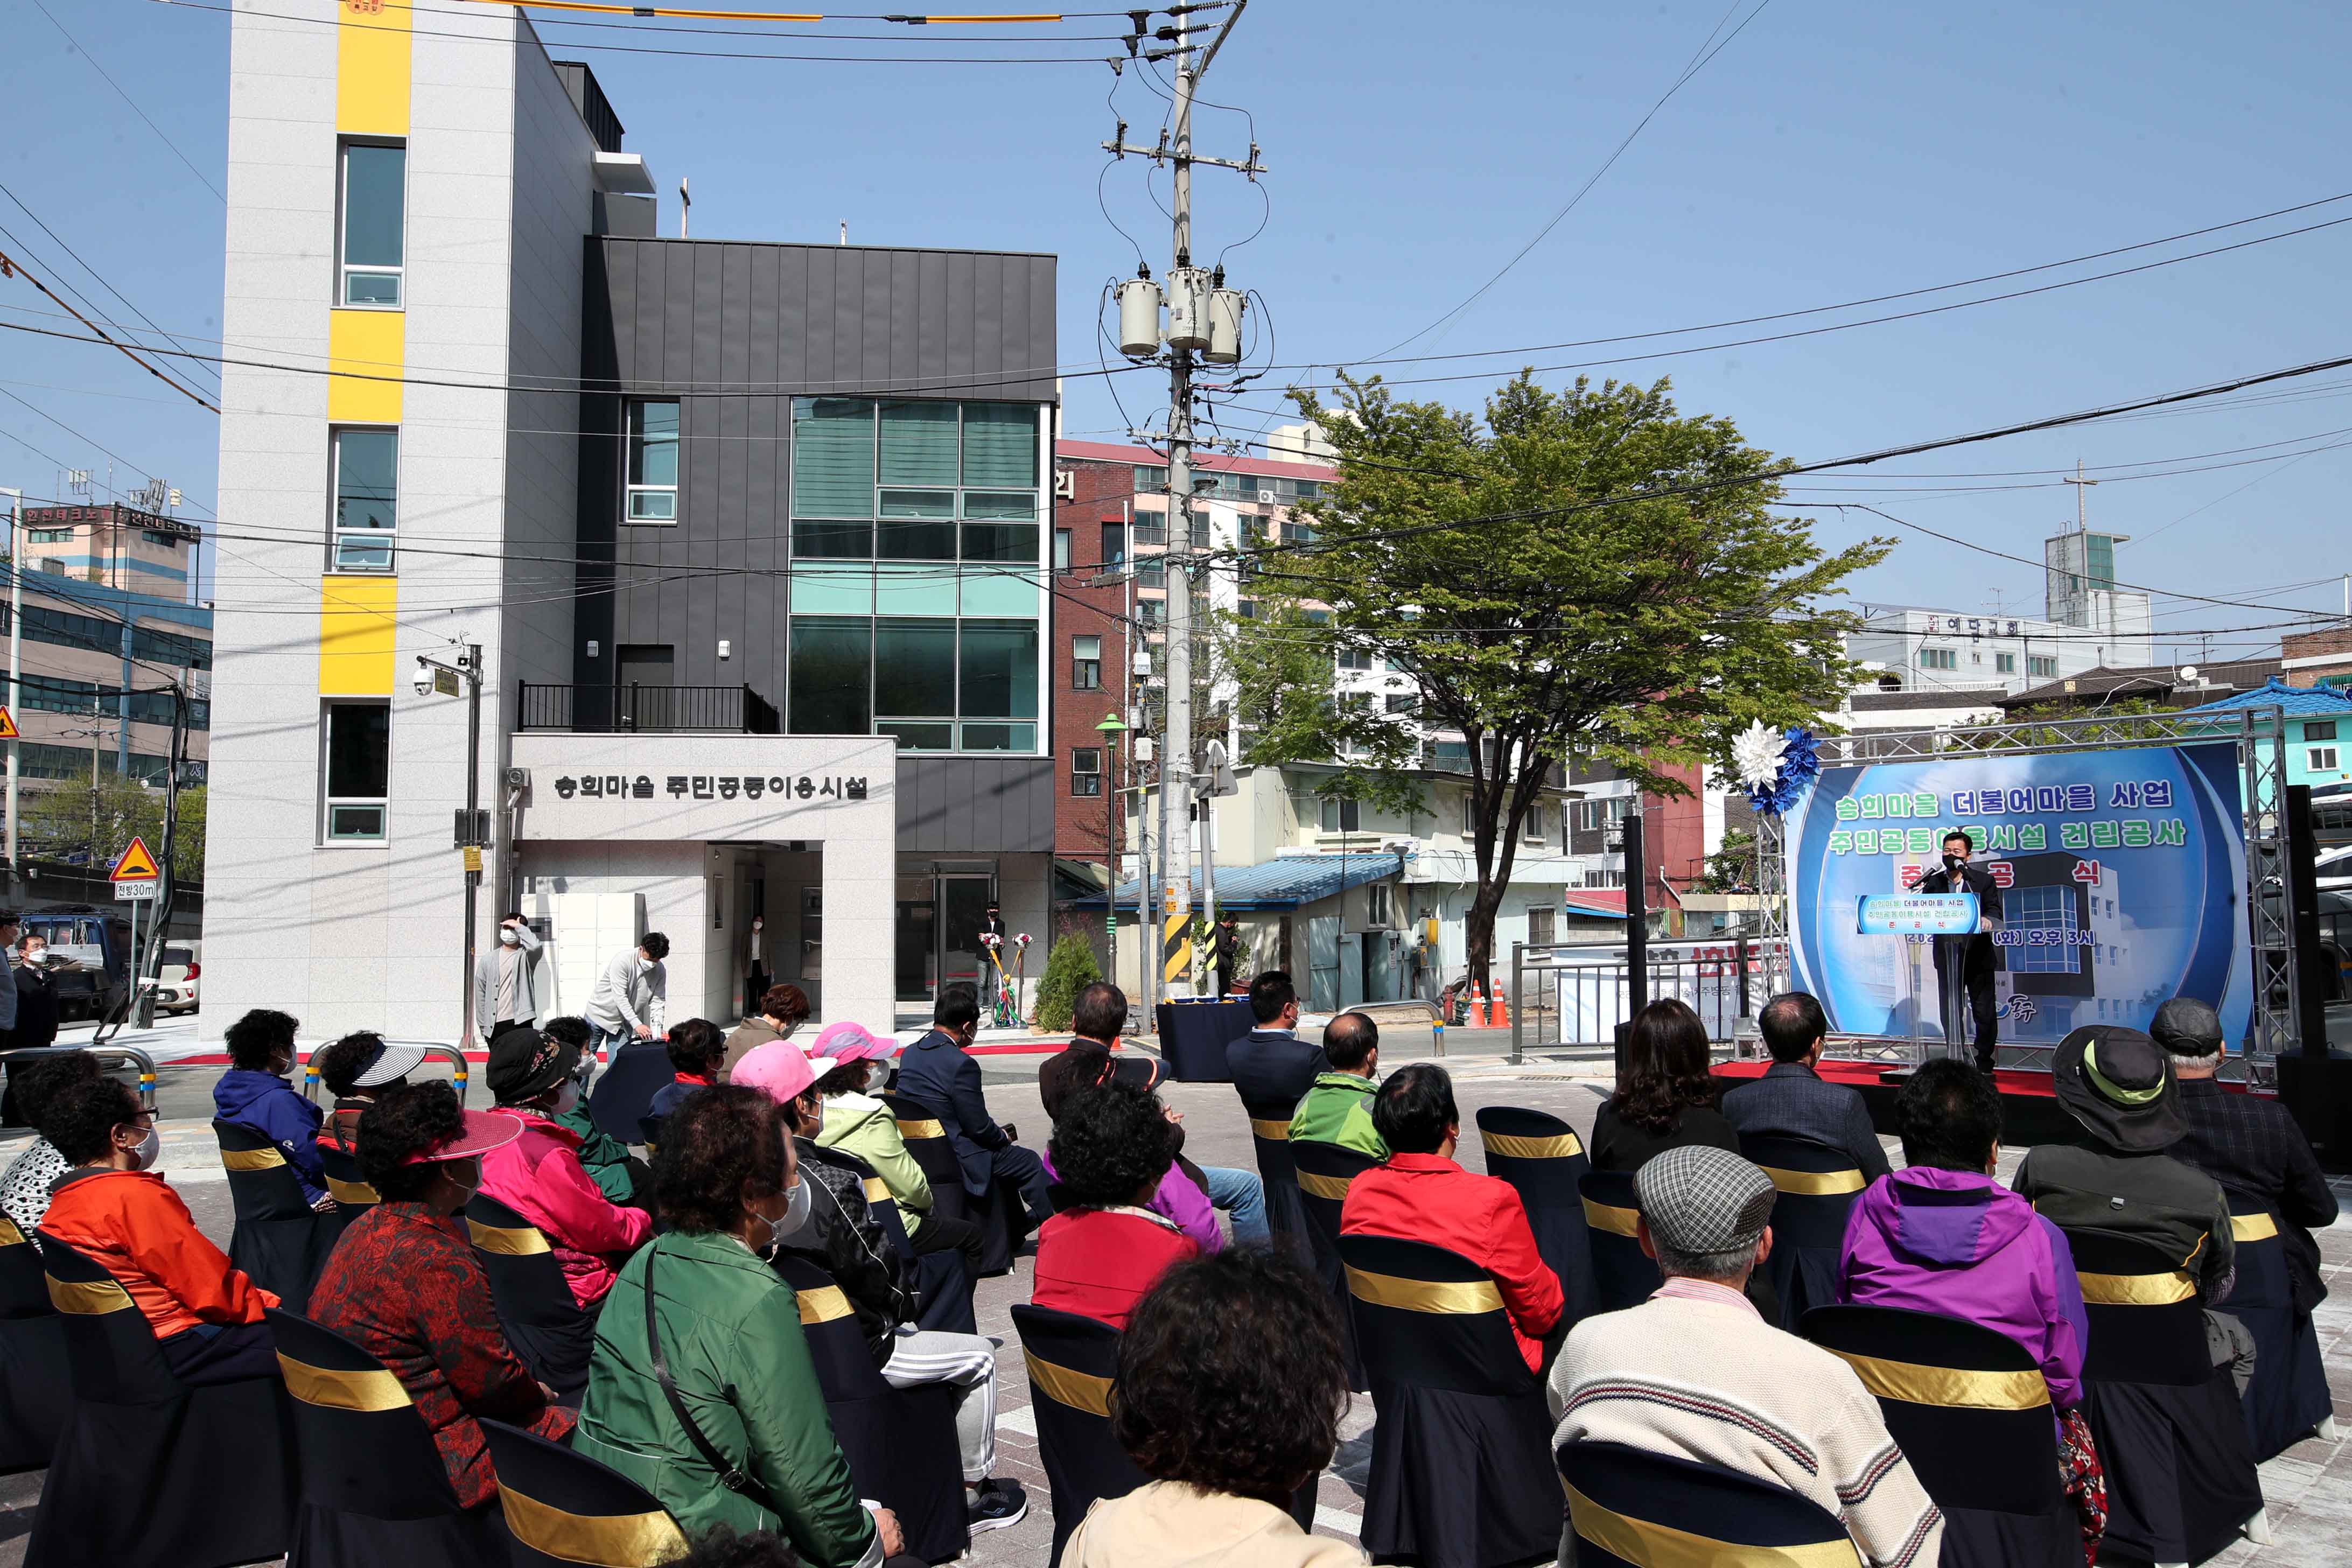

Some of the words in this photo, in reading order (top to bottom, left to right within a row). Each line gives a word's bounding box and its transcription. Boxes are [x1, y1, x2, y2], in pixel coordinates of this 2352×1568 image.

[554, 775, 655, 799] 송희마을
[666, 775, 868, 800] 주민공동이용시설
[1836, 793, 1938, 820] 송희마을
[1952, 784, 2095, 815] 더불어마을
[2110, 779, 2172, 808] 사업
[2061, 818, 2186, 849] 건립공사
[2072, 859, 2101, 887] 식
[117, 883, 154, 897] 전방30m
[1867, 910, 1931, 919] 주민공동이용시설
[1934, 909, 1968, 919] 건립공사
[1869, 900, 1901, 908] 송희마을
[1904, 899, 1944, 907] 더불어마을
[1947, 899, 1964, 907] 사업
[2029, 929, 2063, 947] 오후
[2067, 929, 2096, 947] 3시
[2007, 993, 2037, 1023] 동구
